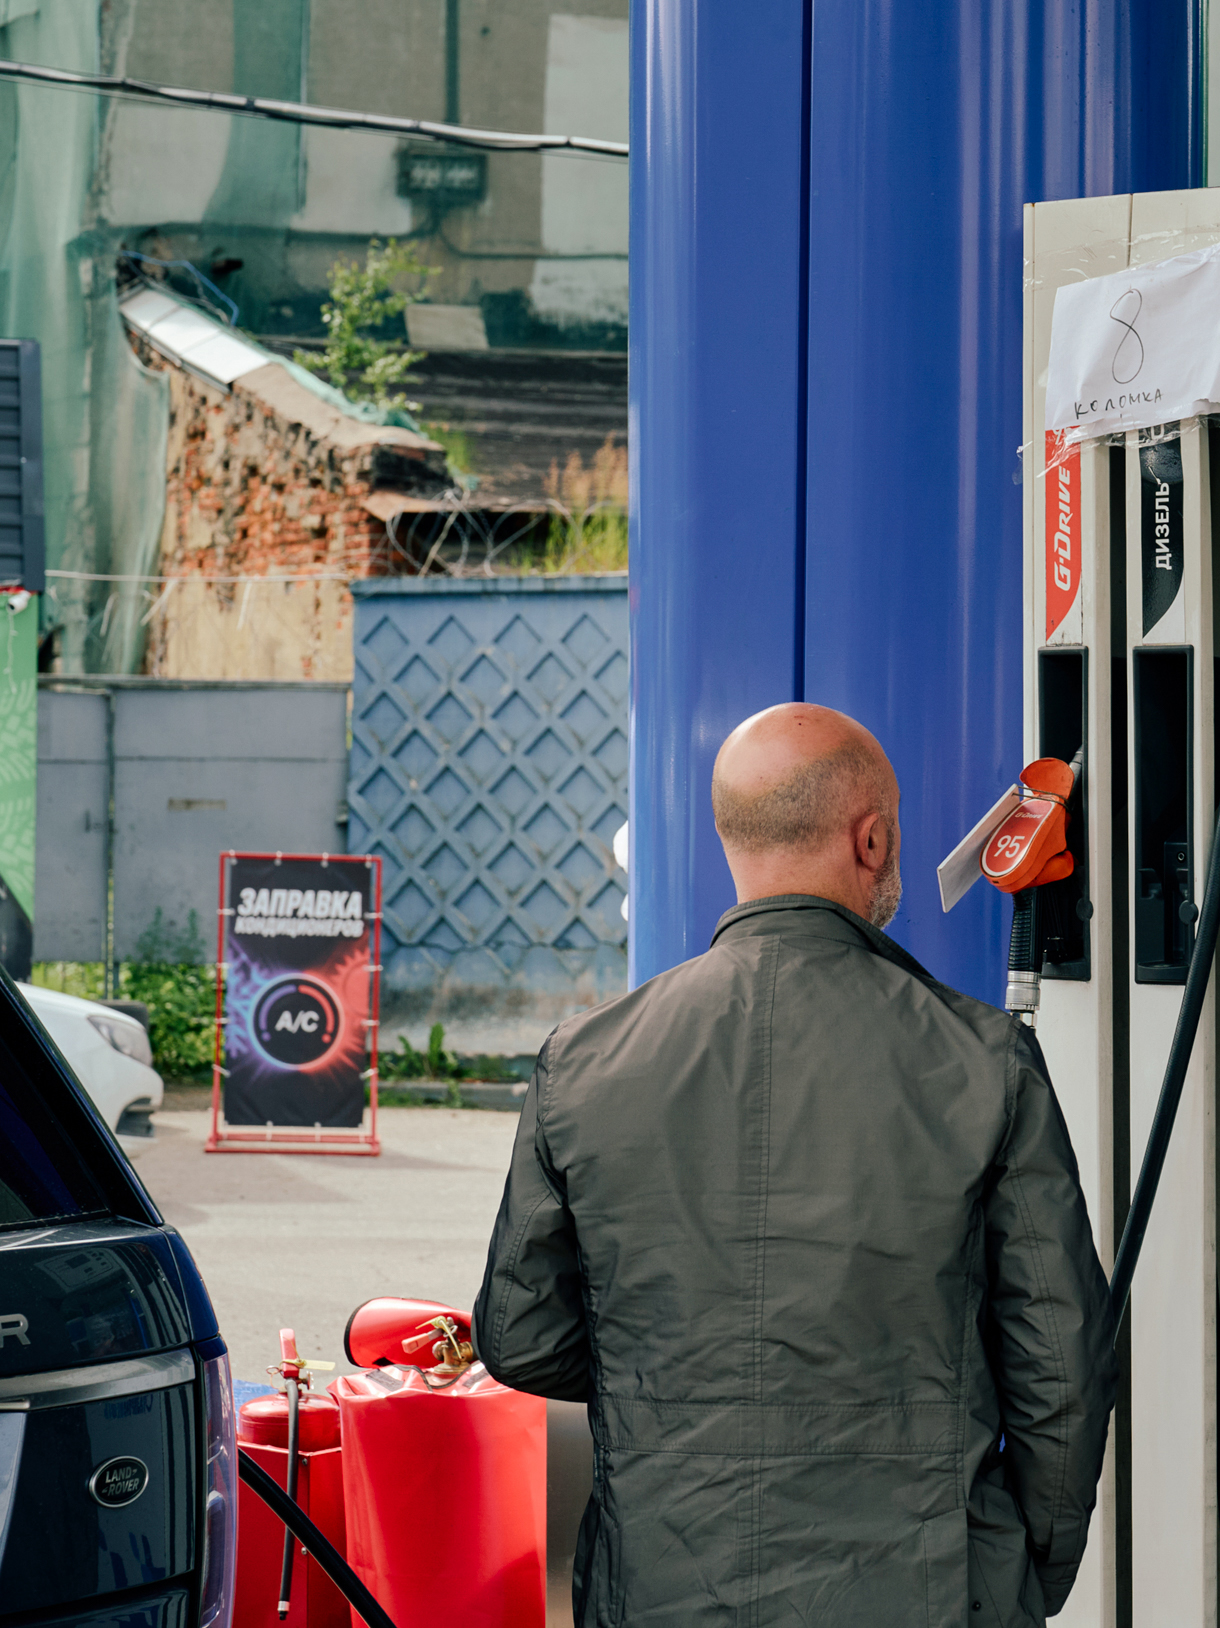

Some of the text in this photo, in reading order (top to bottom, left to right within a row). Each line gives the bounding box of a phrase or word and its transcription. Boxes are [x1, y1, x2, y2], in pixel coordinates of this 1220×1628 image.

[1109, 287, 1145, 385] 8
[1155, 481, 1173, 570] ДИЗЕЛЬ
[993, 835, 1026, 859] 95
[237, 887, 363, 920] ЗАПРАВКА
[234, 916, 364, 938] КОНДИЦИОНЕРОВ
[275, 1010, 319, 1033] A/C
[105, 1466, 132, 1484] LAND
[107, 1477, 140, 1497] ROVER
